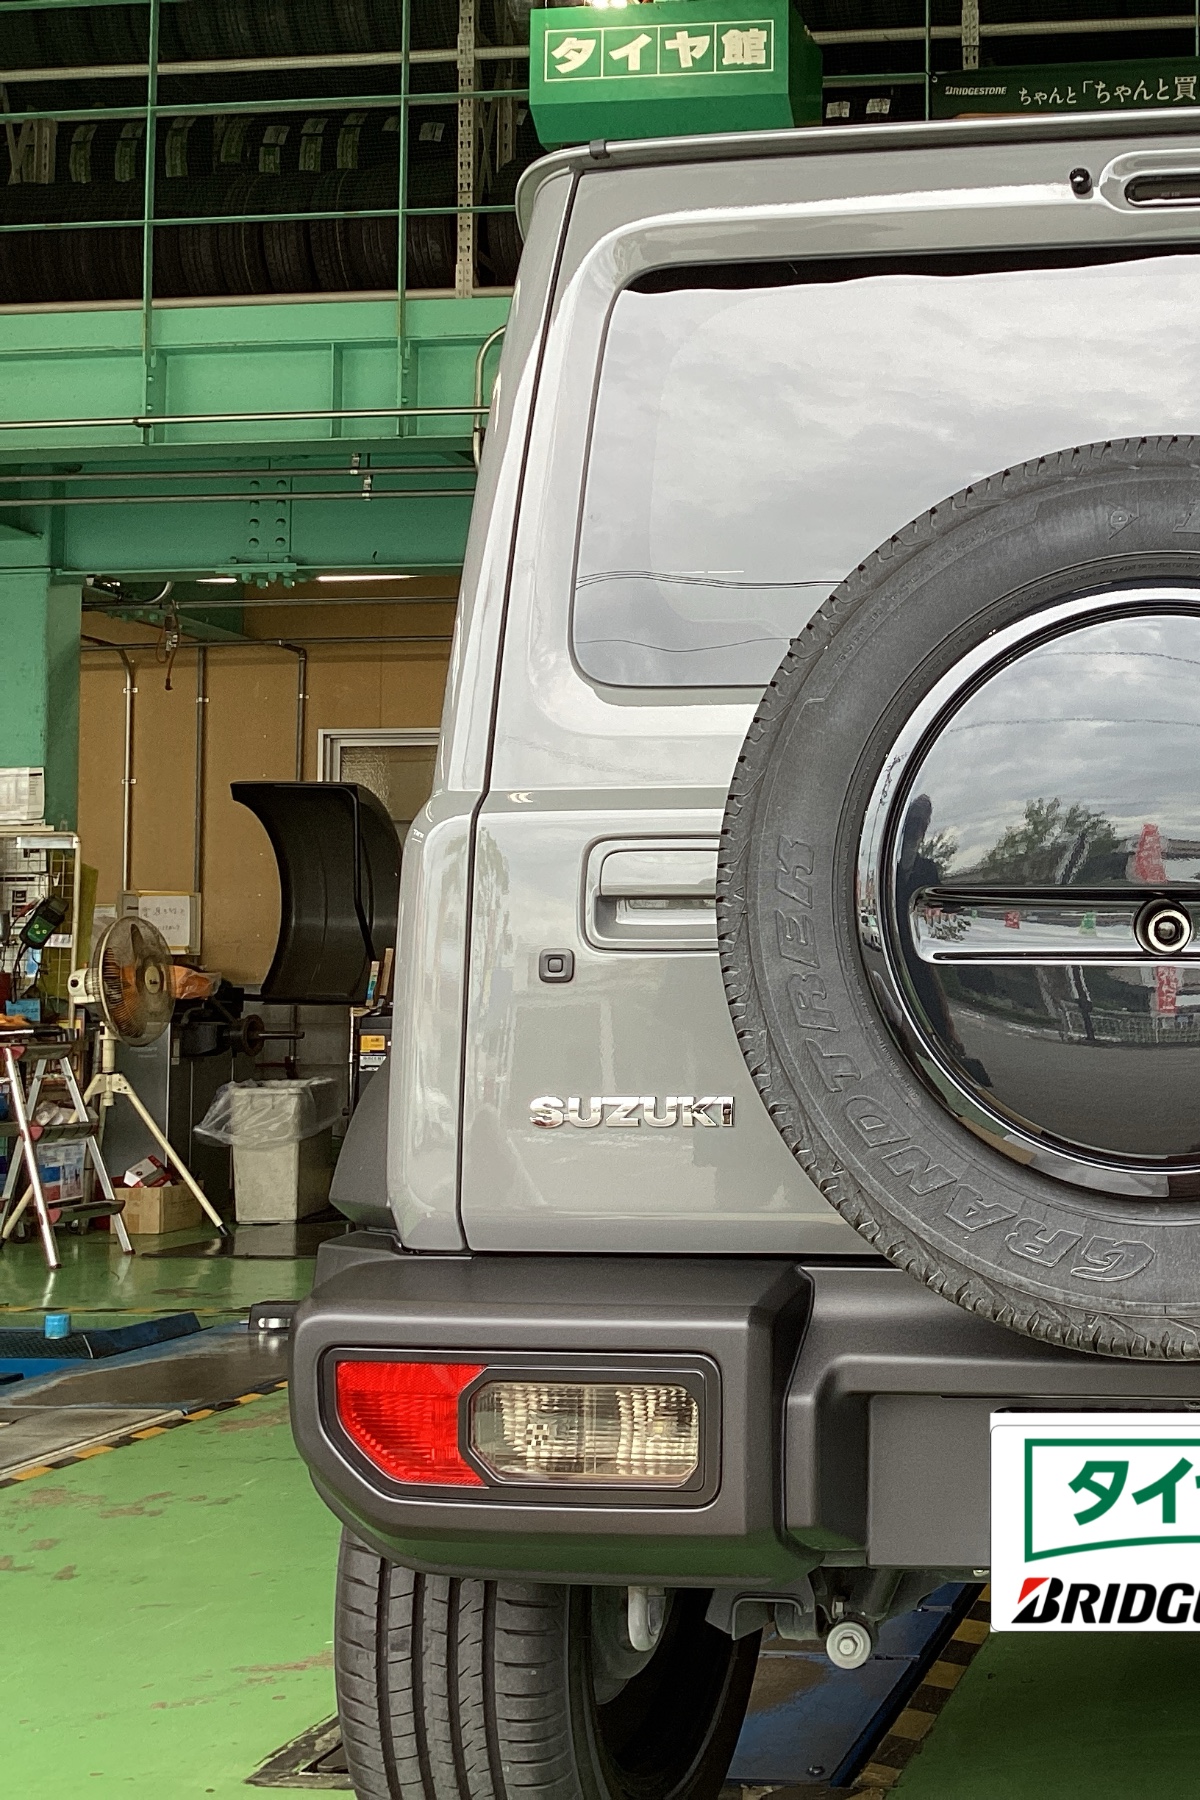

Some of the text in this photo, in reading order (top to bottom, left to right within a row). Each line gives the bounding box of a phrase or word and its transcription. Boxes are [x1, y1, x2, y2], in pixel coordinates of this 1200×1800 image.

[551, 28, 767, 74] タイヤ館
[945, 86, 1007, 96] BRIDGESTONE
[782, 838, 1155, 1282] GRANDTREK
[529, 1095, 734, 1128] SUZUKI
